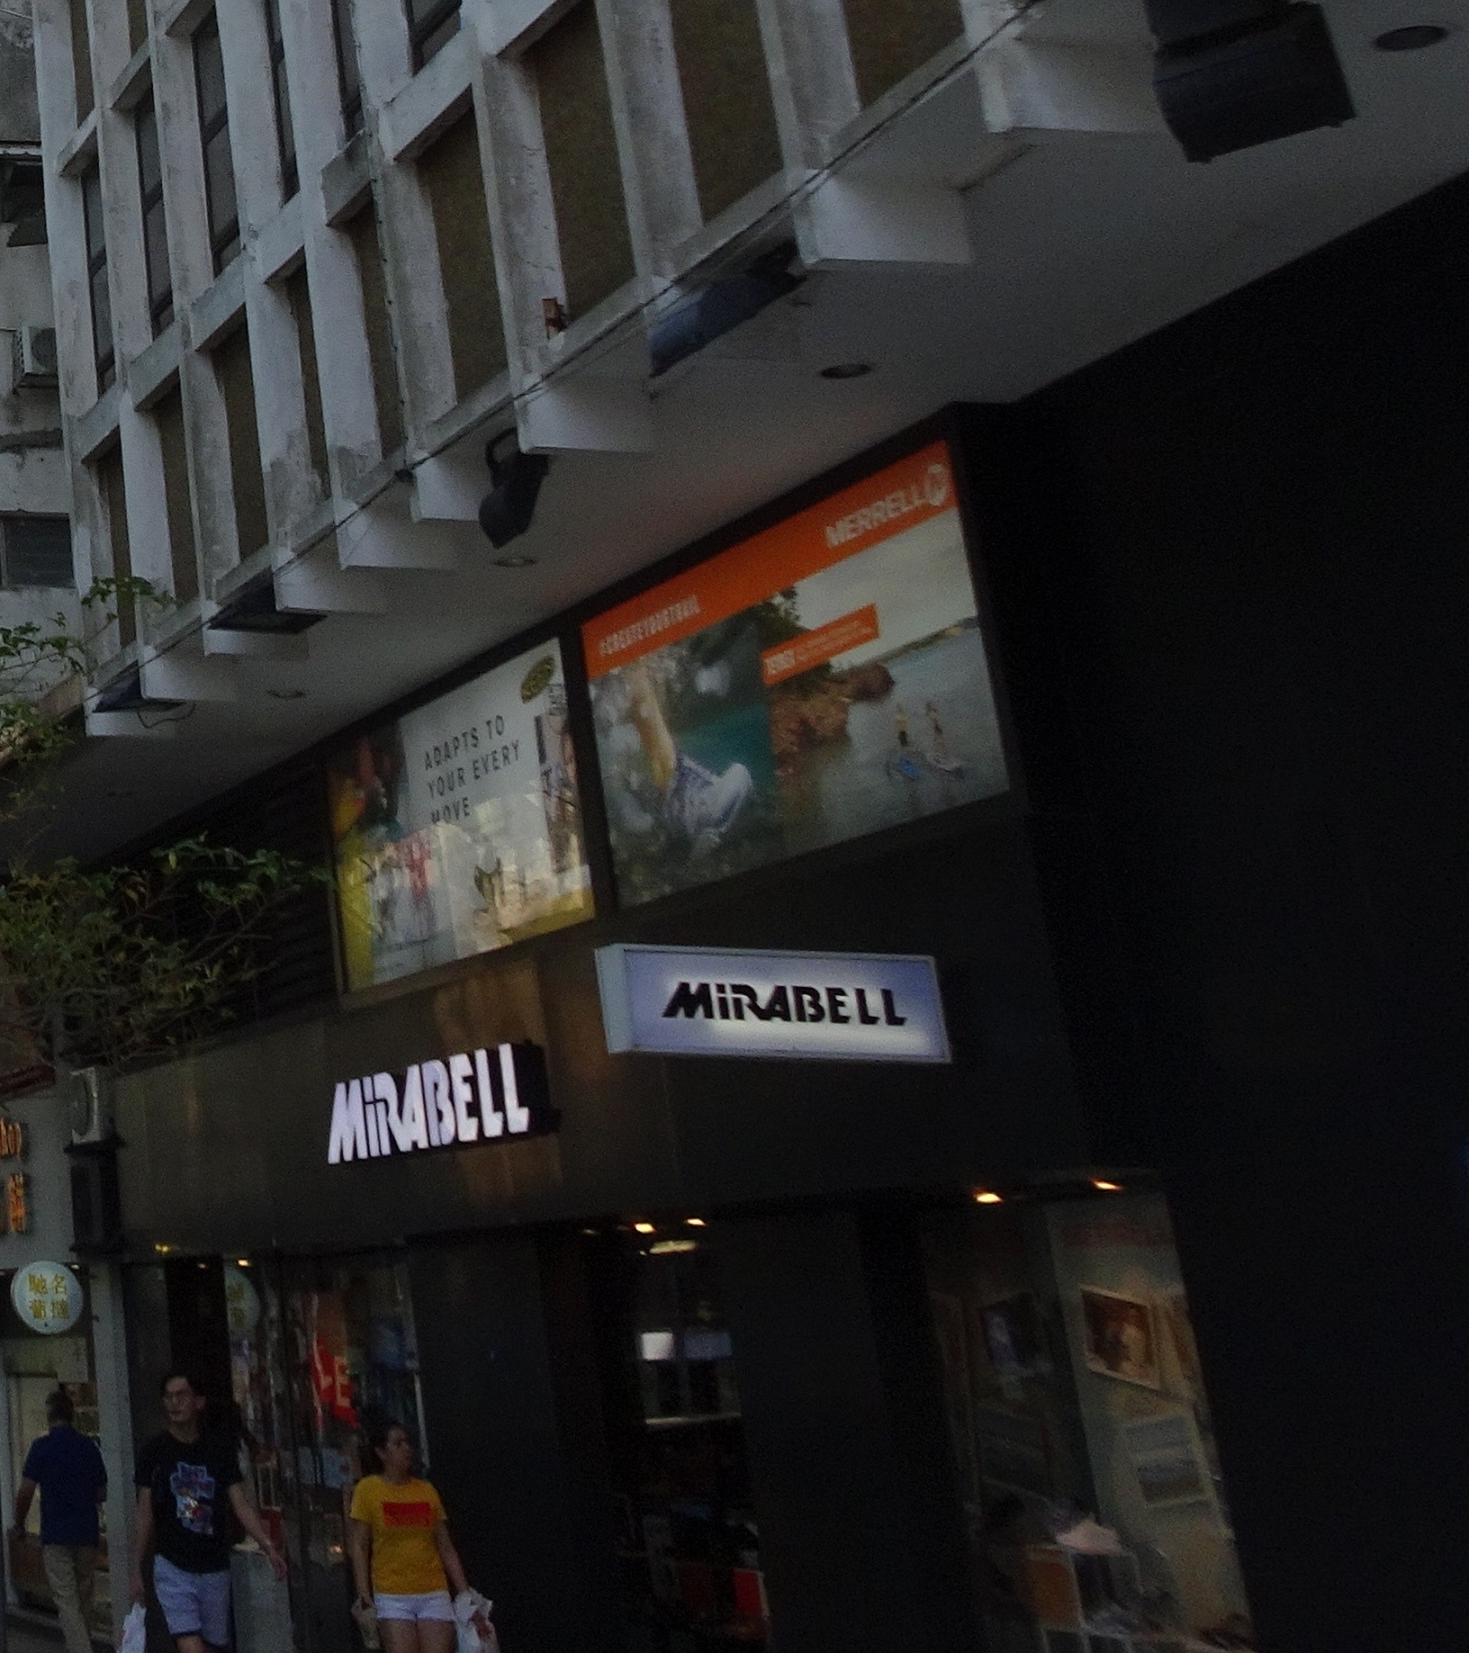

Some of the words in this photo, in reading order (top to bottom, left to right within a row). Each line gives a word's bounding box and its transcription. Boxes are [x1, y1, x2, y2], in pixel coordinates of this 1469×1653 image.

[423, 726, 480, 772] ADAPTS
[485, 714, 505, 741] TO
[426, 767, 467, 799] YOUR
[472, 739, 521, 781] EVERY
